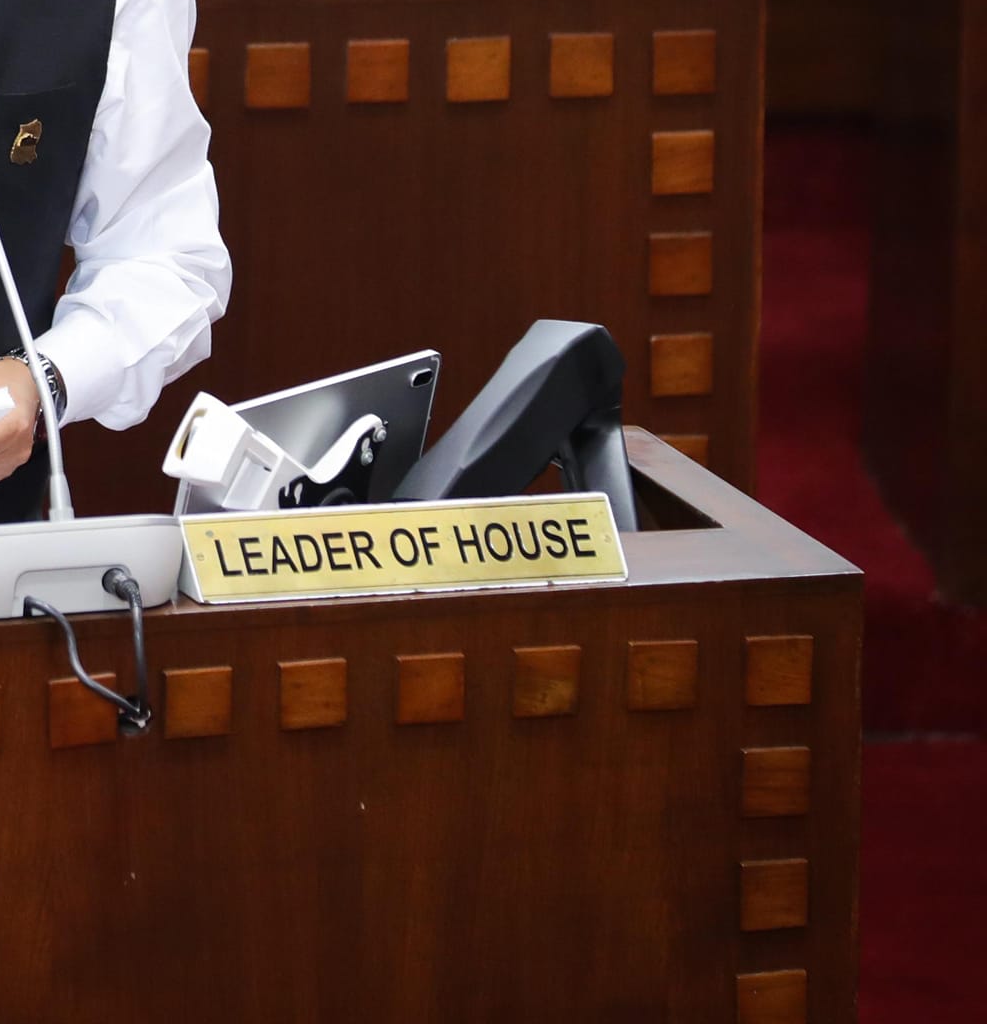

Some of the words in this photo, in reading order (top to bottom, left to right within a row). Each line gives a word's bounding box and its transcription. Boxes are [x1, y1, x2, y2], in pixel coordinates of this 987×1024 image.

[214, 530, 383, 577] LEADER
[389, 527, 441, 568] OF
[452, 518, 596, 564] HOUSE
